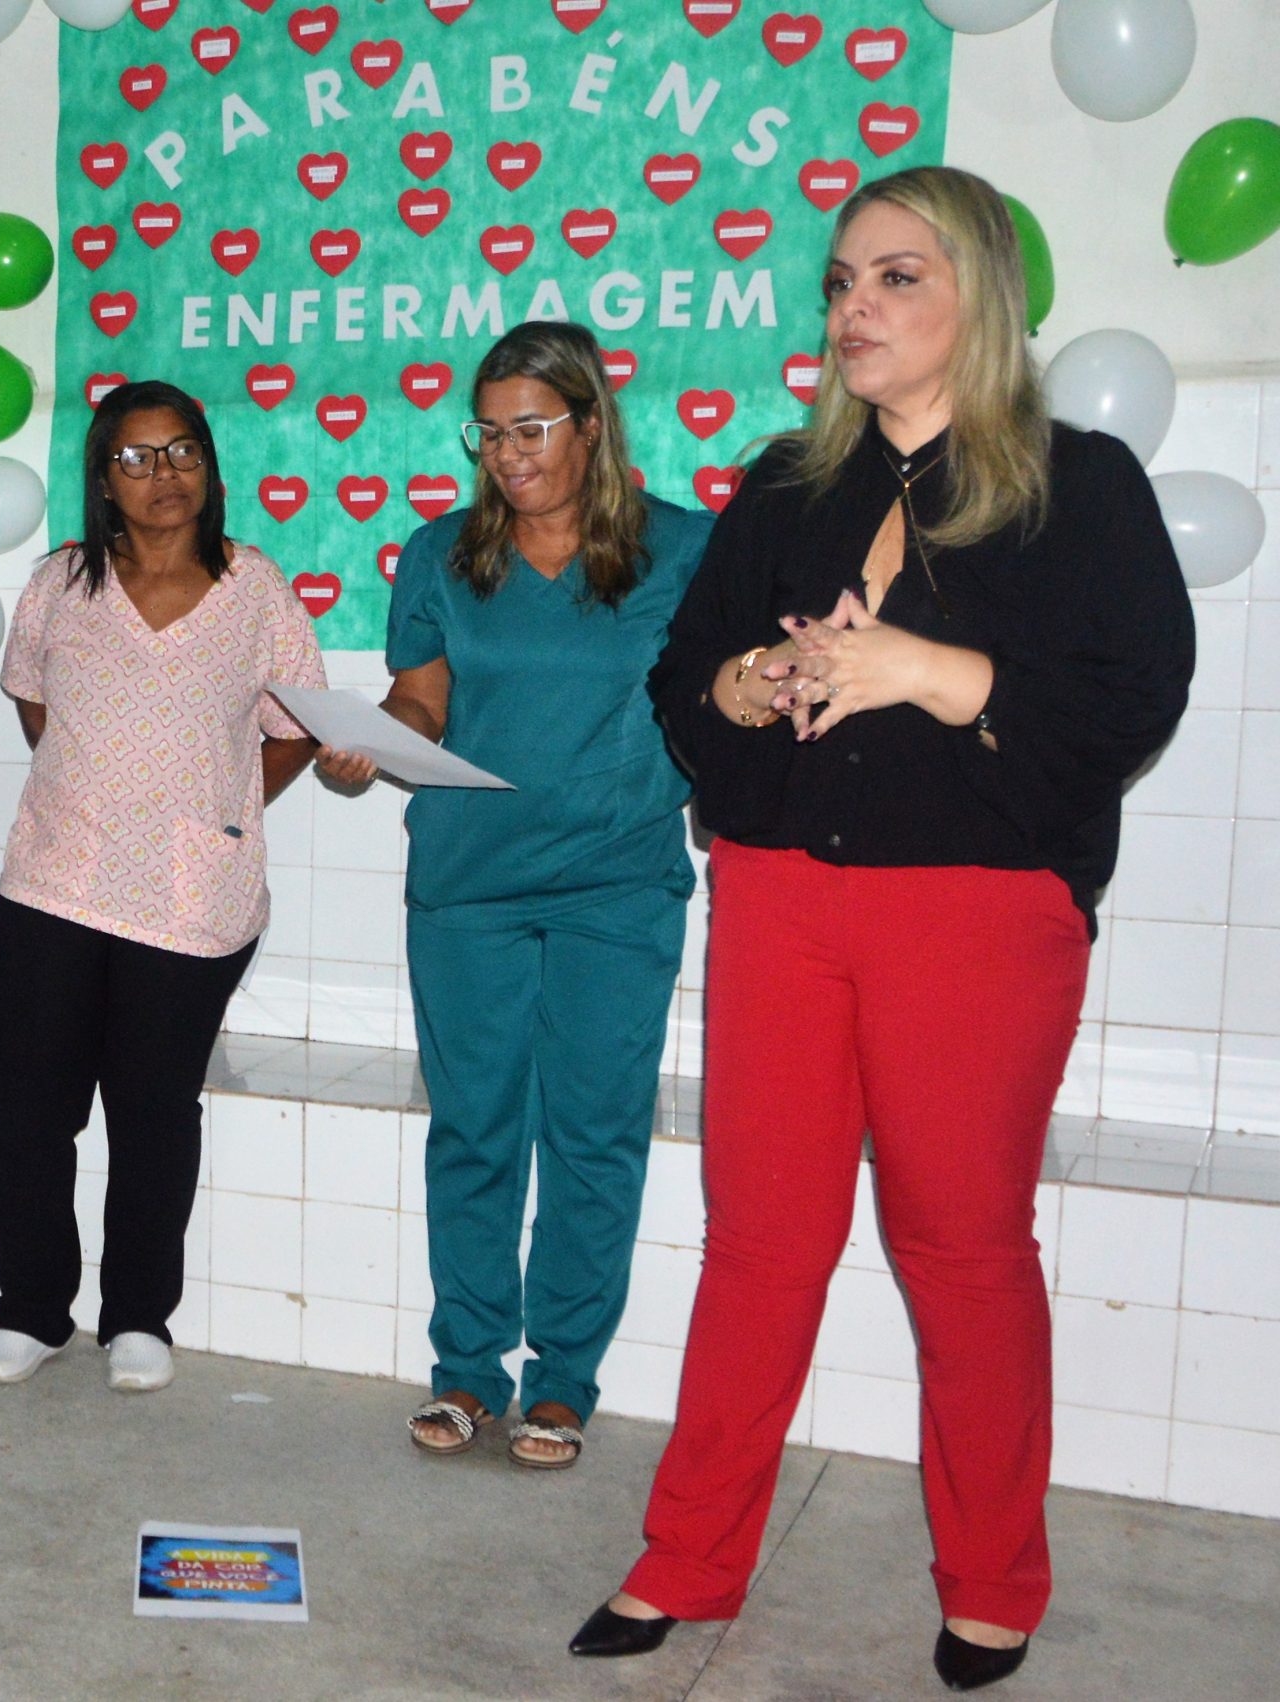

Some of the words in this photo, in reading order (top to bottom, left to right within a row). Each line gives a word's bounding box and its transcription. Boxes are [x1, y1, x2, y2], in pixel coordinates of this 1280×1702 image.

[144, 30, 790, 190] PARABÉNS
[181, 269, 777, 348] ENFERMAGEM
[194, 1551, 245, 1562] VIDA
[214, 1563, 262, 1571] COR
[161, 1569, 208, 1579] QUE
